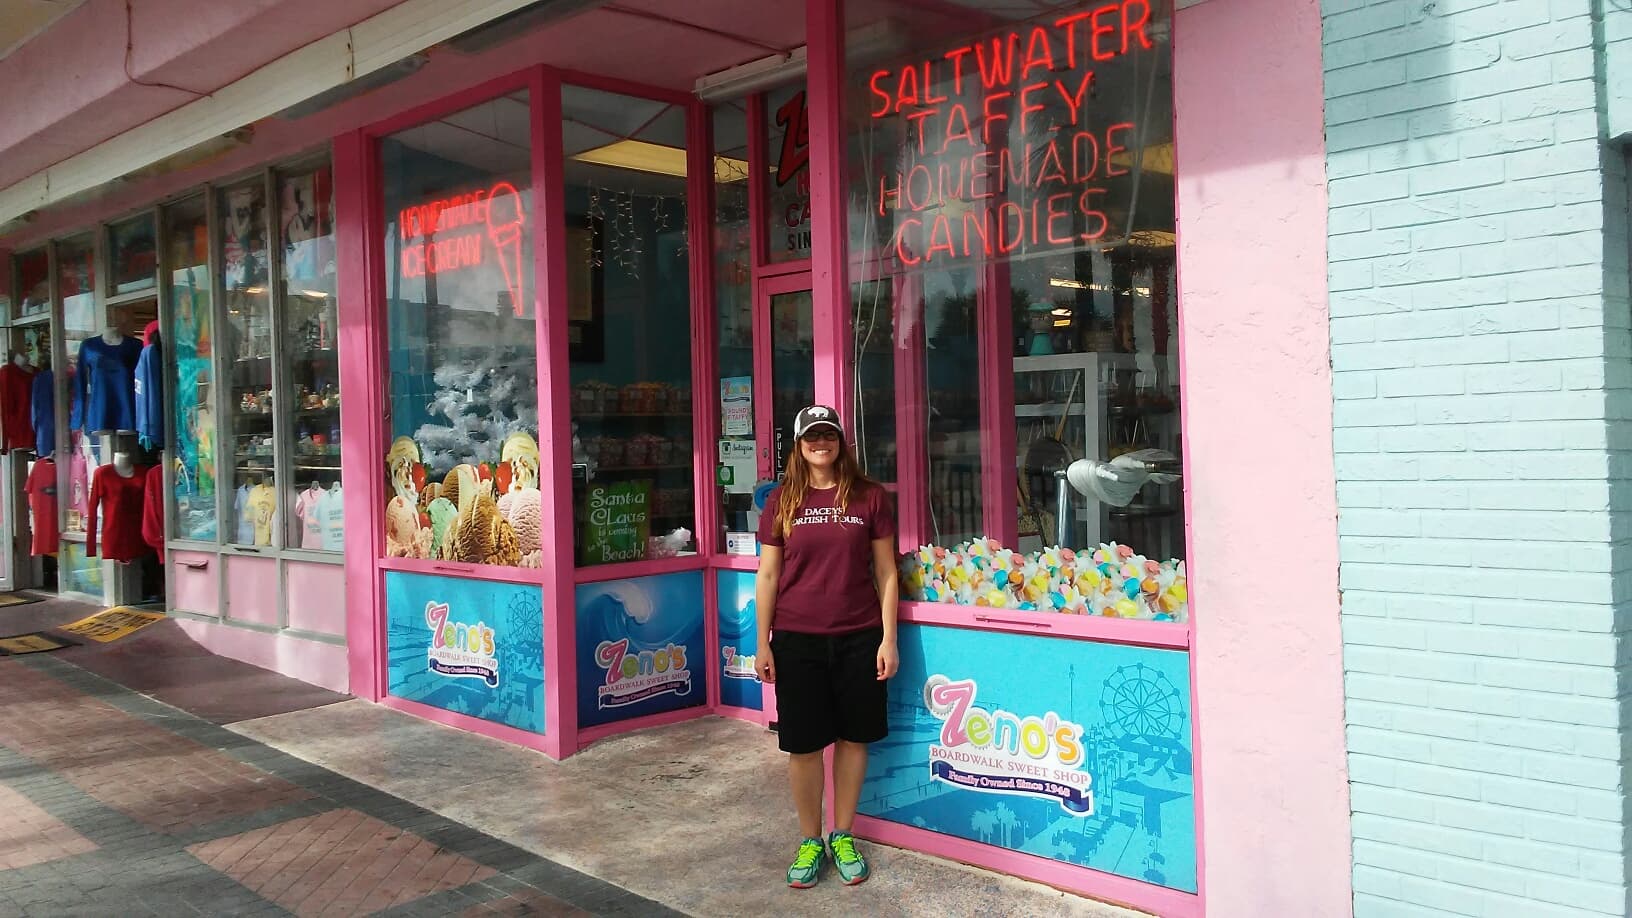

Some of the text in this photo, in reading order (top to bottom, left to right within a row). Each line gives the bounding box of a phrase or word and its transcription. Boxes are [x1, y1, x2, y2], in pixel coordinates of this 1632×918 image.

[870, 0, 1152, 118] SALTWATER
[907, 71, 1094, 155] TAFFY
[880, 122, 1135, 216] HOMEMADE
[896, 188, 1108, 266] CANDIES
[591, 488, 646, 508] Santa
[602, 541, 645, 561] Beach!
[428, 603, 494, 655] Zeno's
[600, 640, 686, 684] Zeno's
[932, 680, 1081, 761] Zeno's
[931, 747, 1089, 785] BOARDWALK SWEET SHOP
[948, 770, 980, 787] Family
[980, 776, 1016, 789] Owned
[1016, 777, 1044, 791] Since
